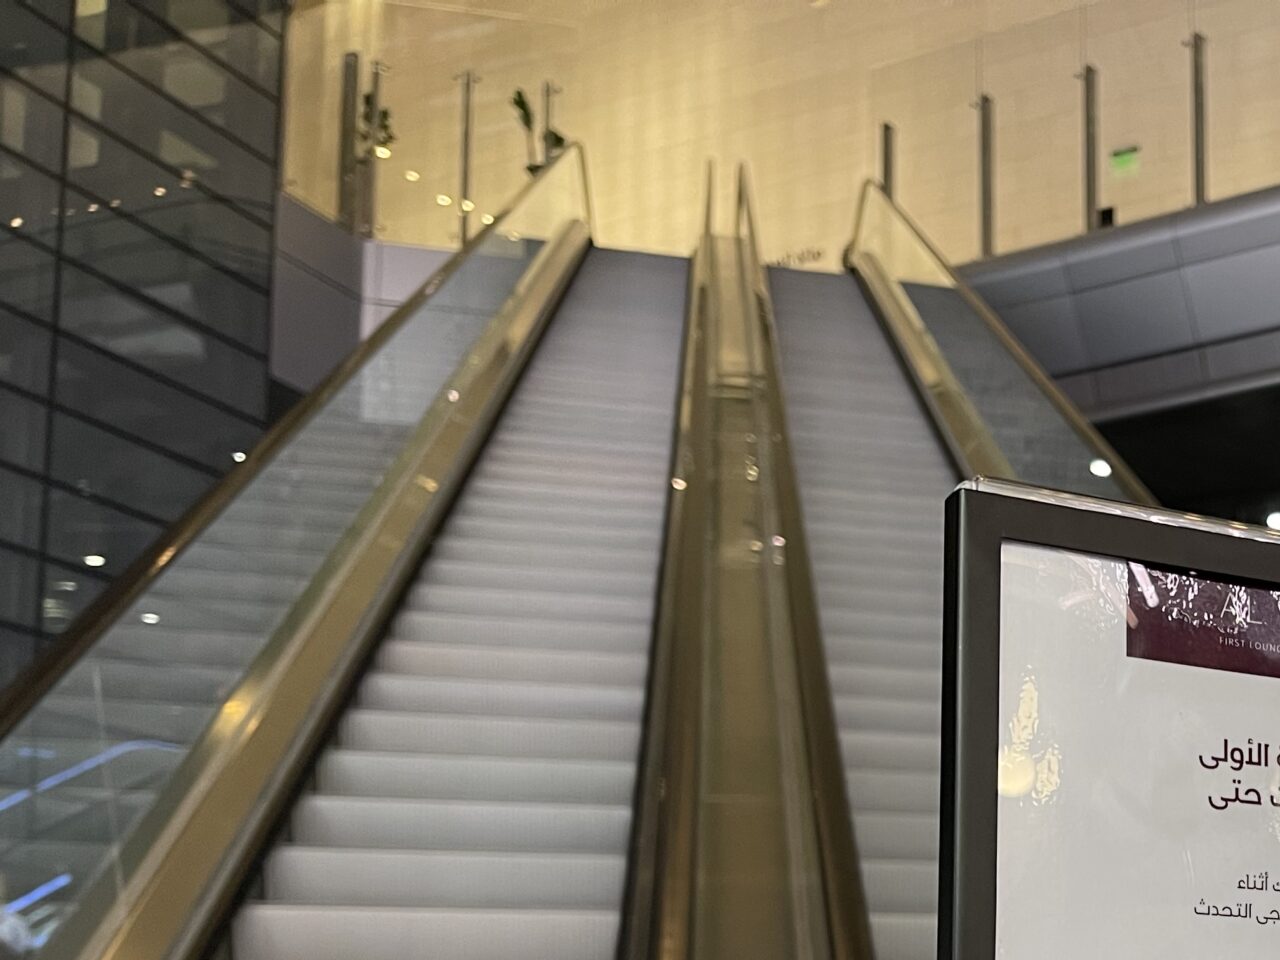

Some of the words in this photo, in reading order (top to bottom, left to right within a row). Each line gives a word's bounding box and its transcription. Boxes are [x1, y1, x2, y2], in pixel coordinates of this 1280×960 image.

[1220, 592, 1263, 625] AL
[1219, 637, 1245, 648] FIRST
[1198, 738, 1269, 771] الأولى
[1208, 779, 1262, 810] حتى
[1237, 872, 1268, 891] أثناء
[1194, 898, 1252, 919] التحدث
